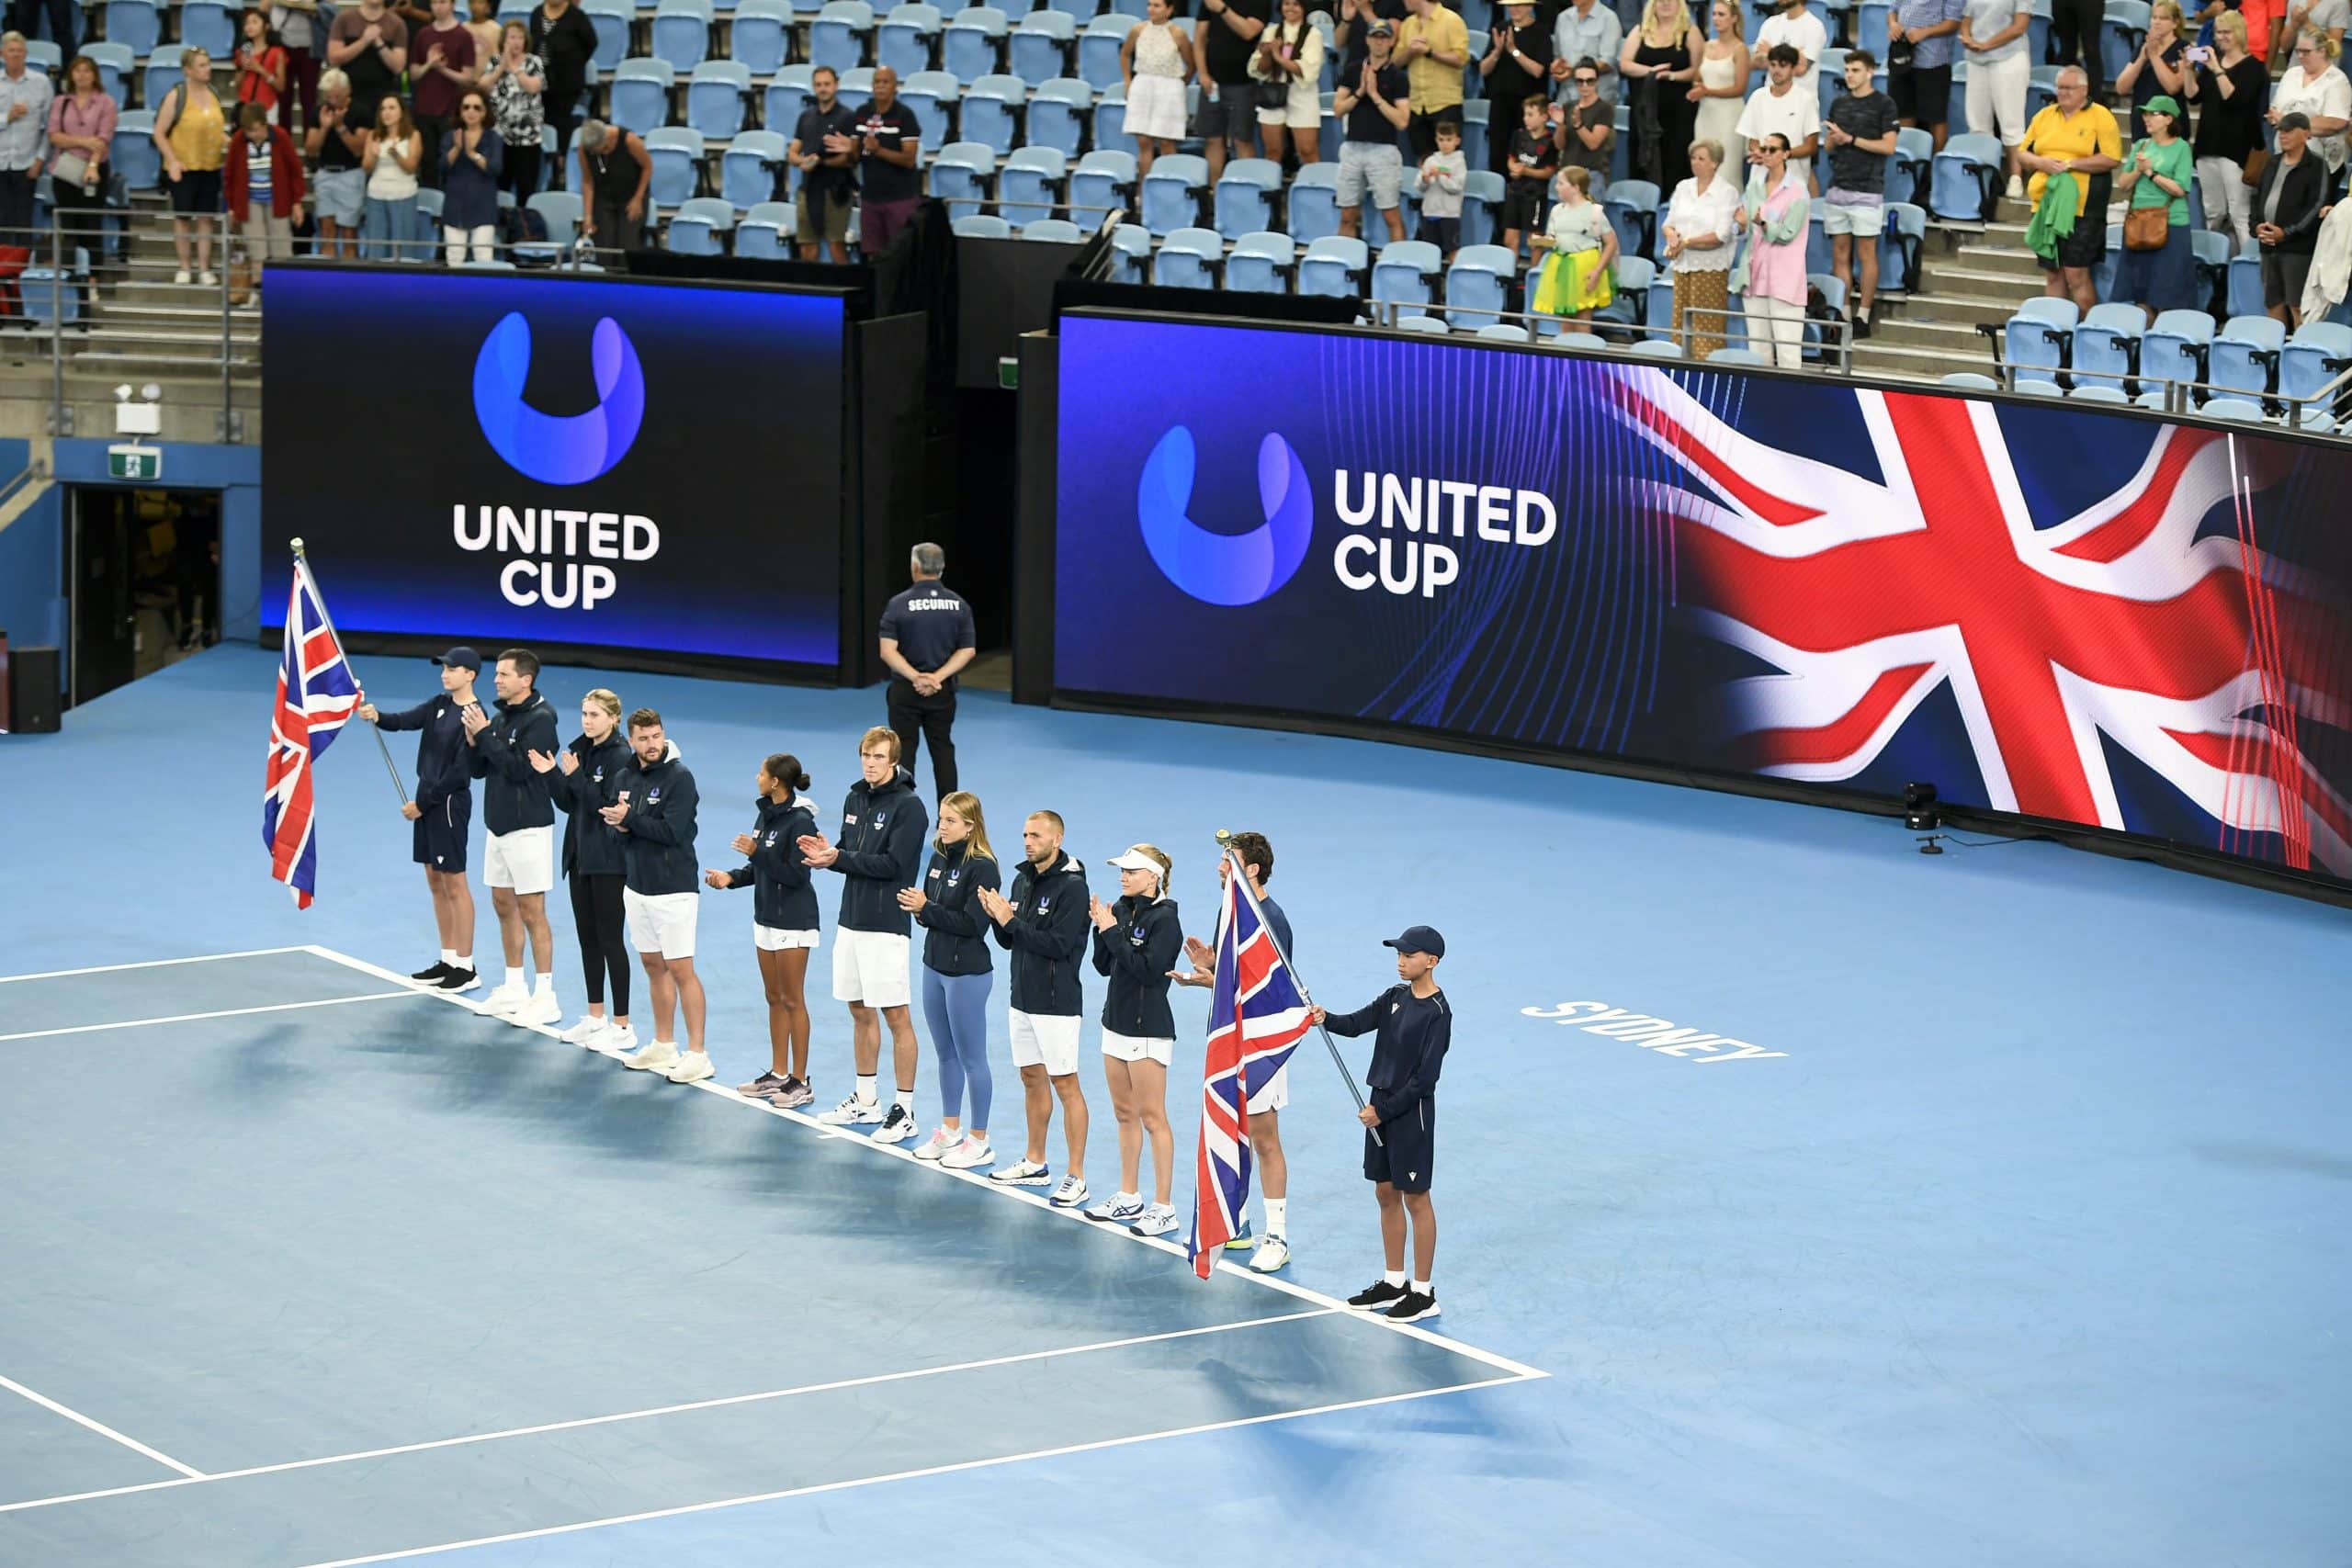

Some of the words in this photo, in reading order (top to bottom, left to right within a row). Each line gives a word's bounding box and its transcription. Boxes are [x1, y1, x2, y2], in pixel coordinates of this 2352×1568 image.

[454, 504, 660, 561] UNITED
[1335, 468, 1557, 547] UNITED
[500, 559, 616, 610] CUP
[1334, 535, 1459, 598] CUP
[908, 599, 960, 612] SECURITY
[1521, 1000, 1791, 1064] SYDNEY
